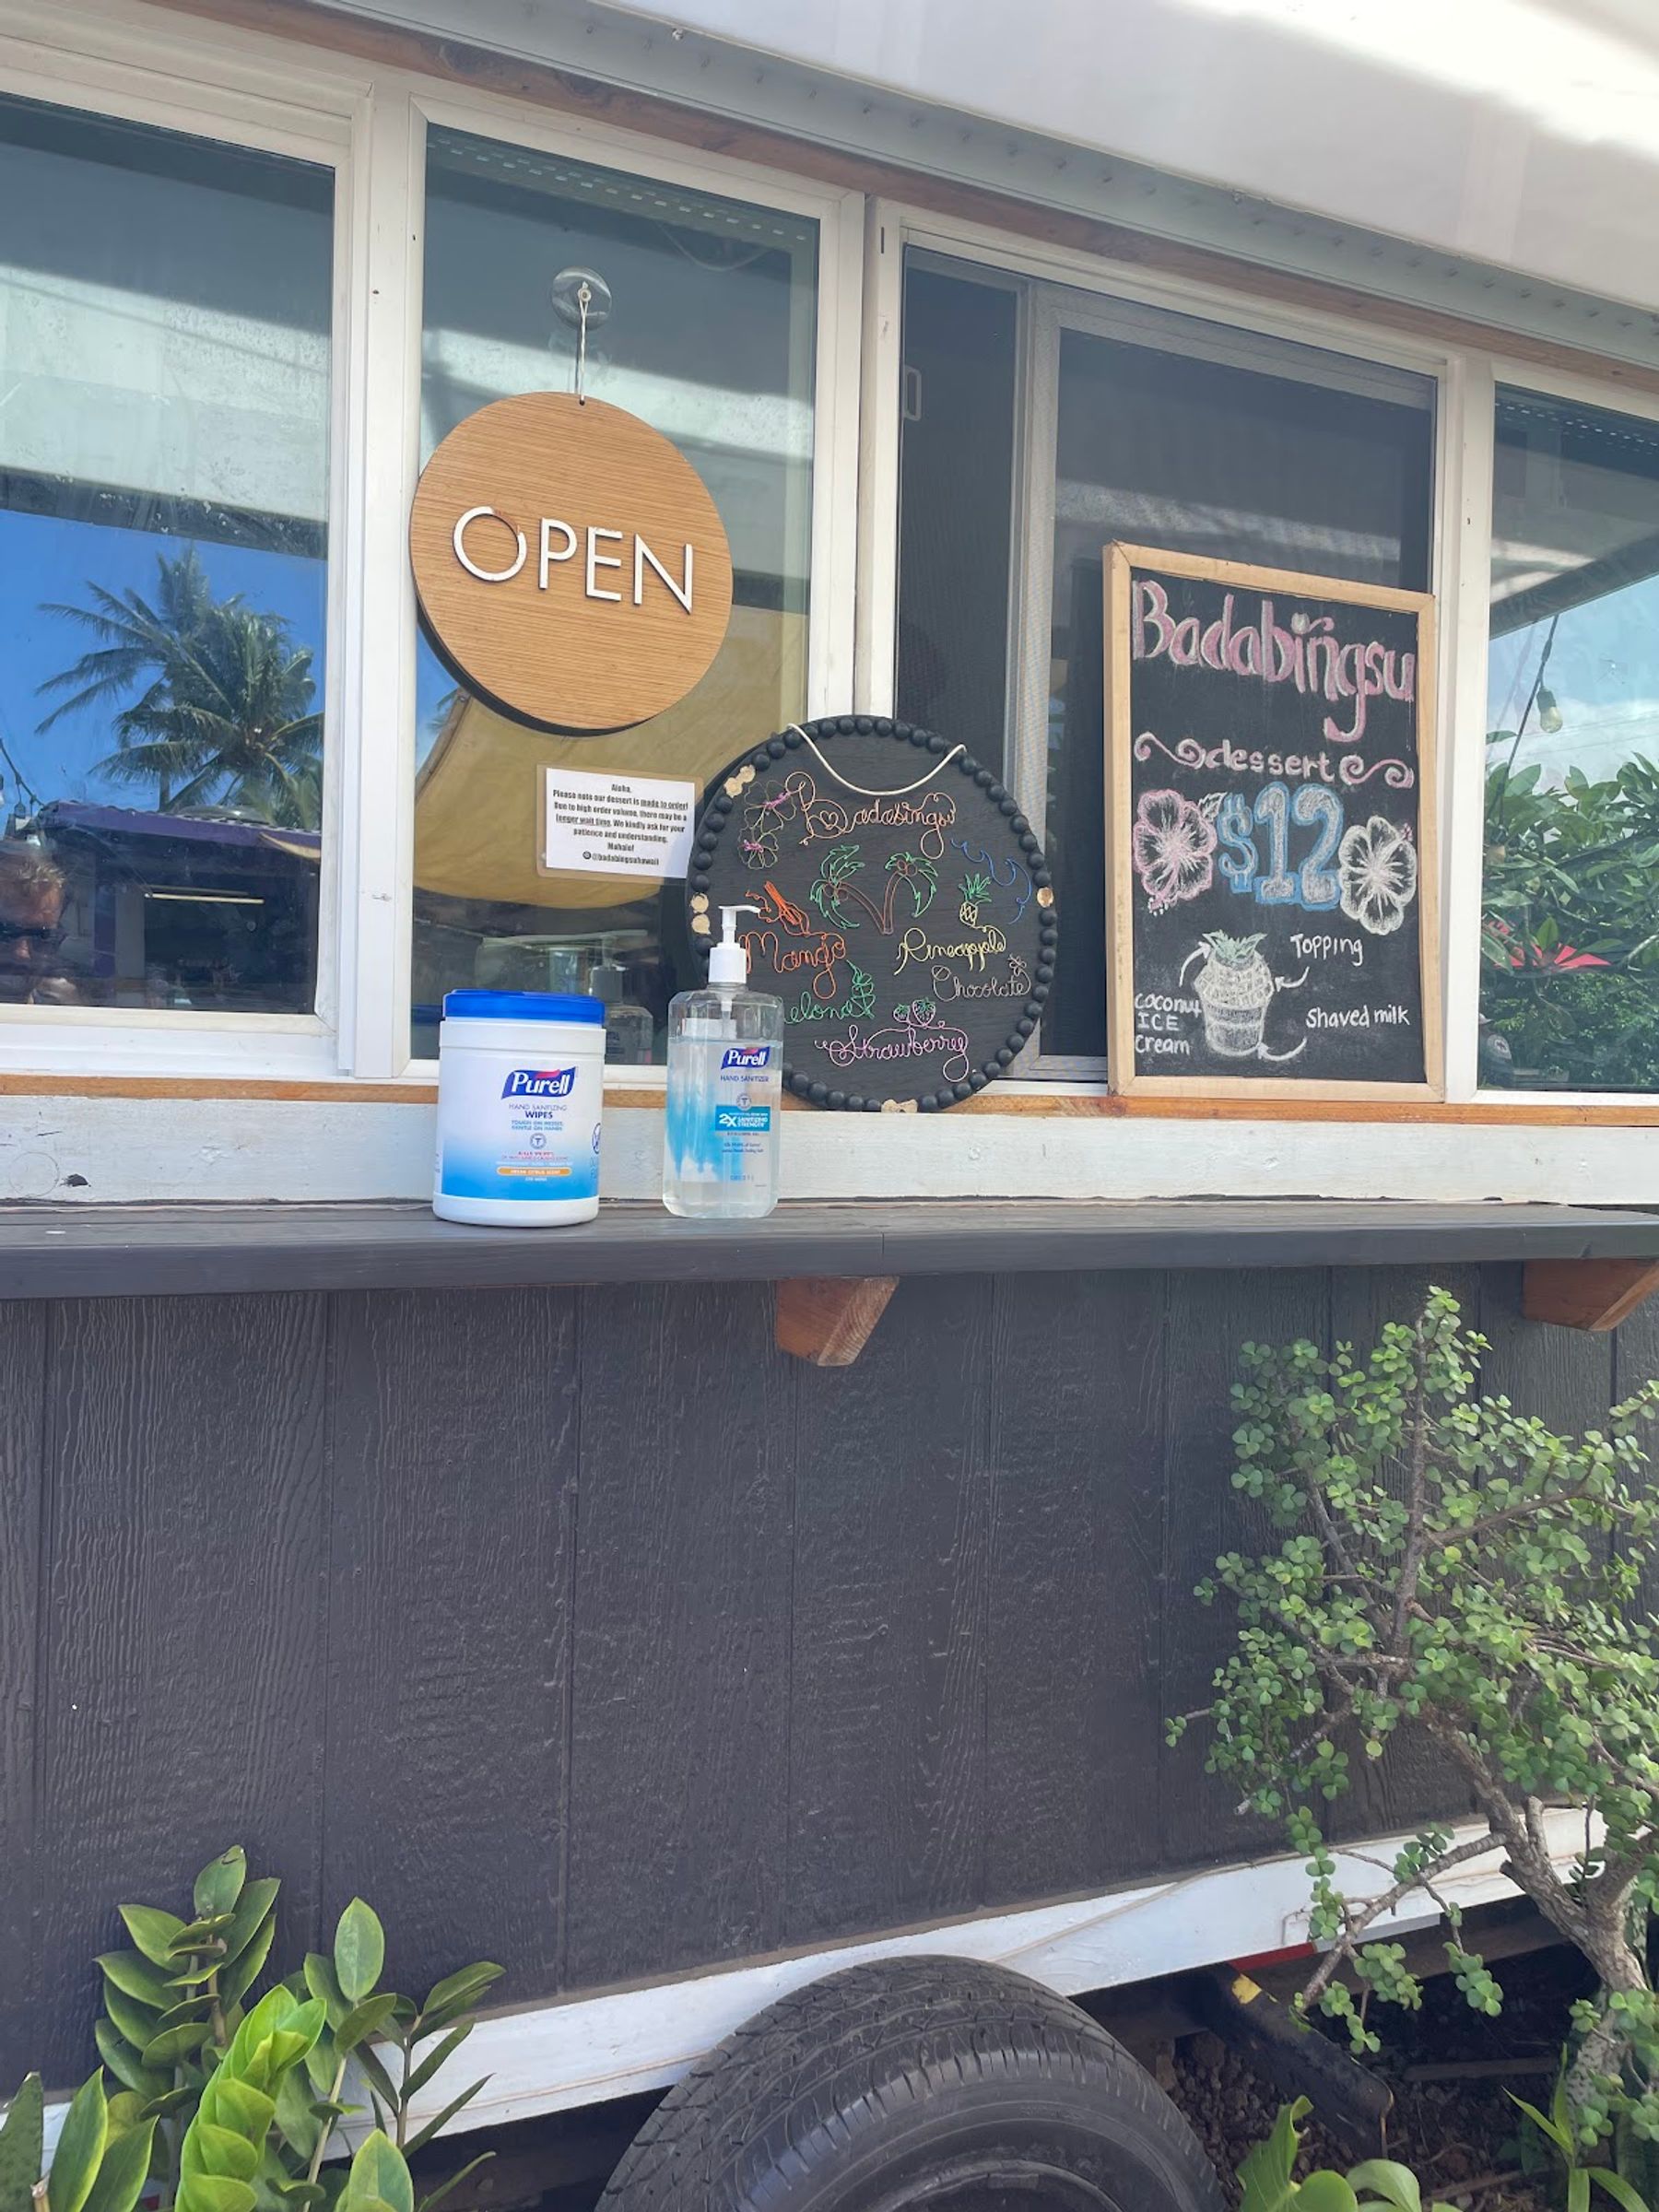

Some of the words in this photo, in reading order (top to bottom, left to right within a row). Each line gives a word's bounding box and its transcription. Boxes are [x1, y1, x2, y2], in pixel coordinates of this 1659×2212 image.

[453, 506, 693, 615] OPEN
[1133, 580, 1416, 742] Badabingsu
[1205, 739, 1335, 782] dessert
[553, 789, 576, 799] Please
[606, 794, 632, 805] dessert
[633, 797, 640, 806] is
[641, 798, 659, 808] made
[554, 802, 568, 810] Due
[569, 803, 576, 811] to
[577, 804, 592, 813] high
[593, 806, 612, 814] order
[658, 812, 673, 821] may
[674, 813, 683, 821] be
[573, 828, 604, 838] patience
[625, 819, 646, 830] kindly
[647, 822, 659, 830] ask
[659, 823, 669, 831] for
[669, 825, 686, 833] your
[1218, 782, 1344, 912] $12
[738, 931, 847, 999] Mango
[894, 927, 1006, 975] Pineapple
[1290, 933, 1363, 967] Topping
[932, 965, 1031, 1002] Chocolate
[784, 991, 857, 1024] elona
[1137, 1012, 1180, 1031] ICE
[1374, 1004, 1410, 1026] milk
[728, 1051, 766, 1065] Purell
[815, 1024, 969, 1082] Strawberry
[511, 1071, 571, 1095] Purell
[524, 1111, 553, 1119] WIPES
